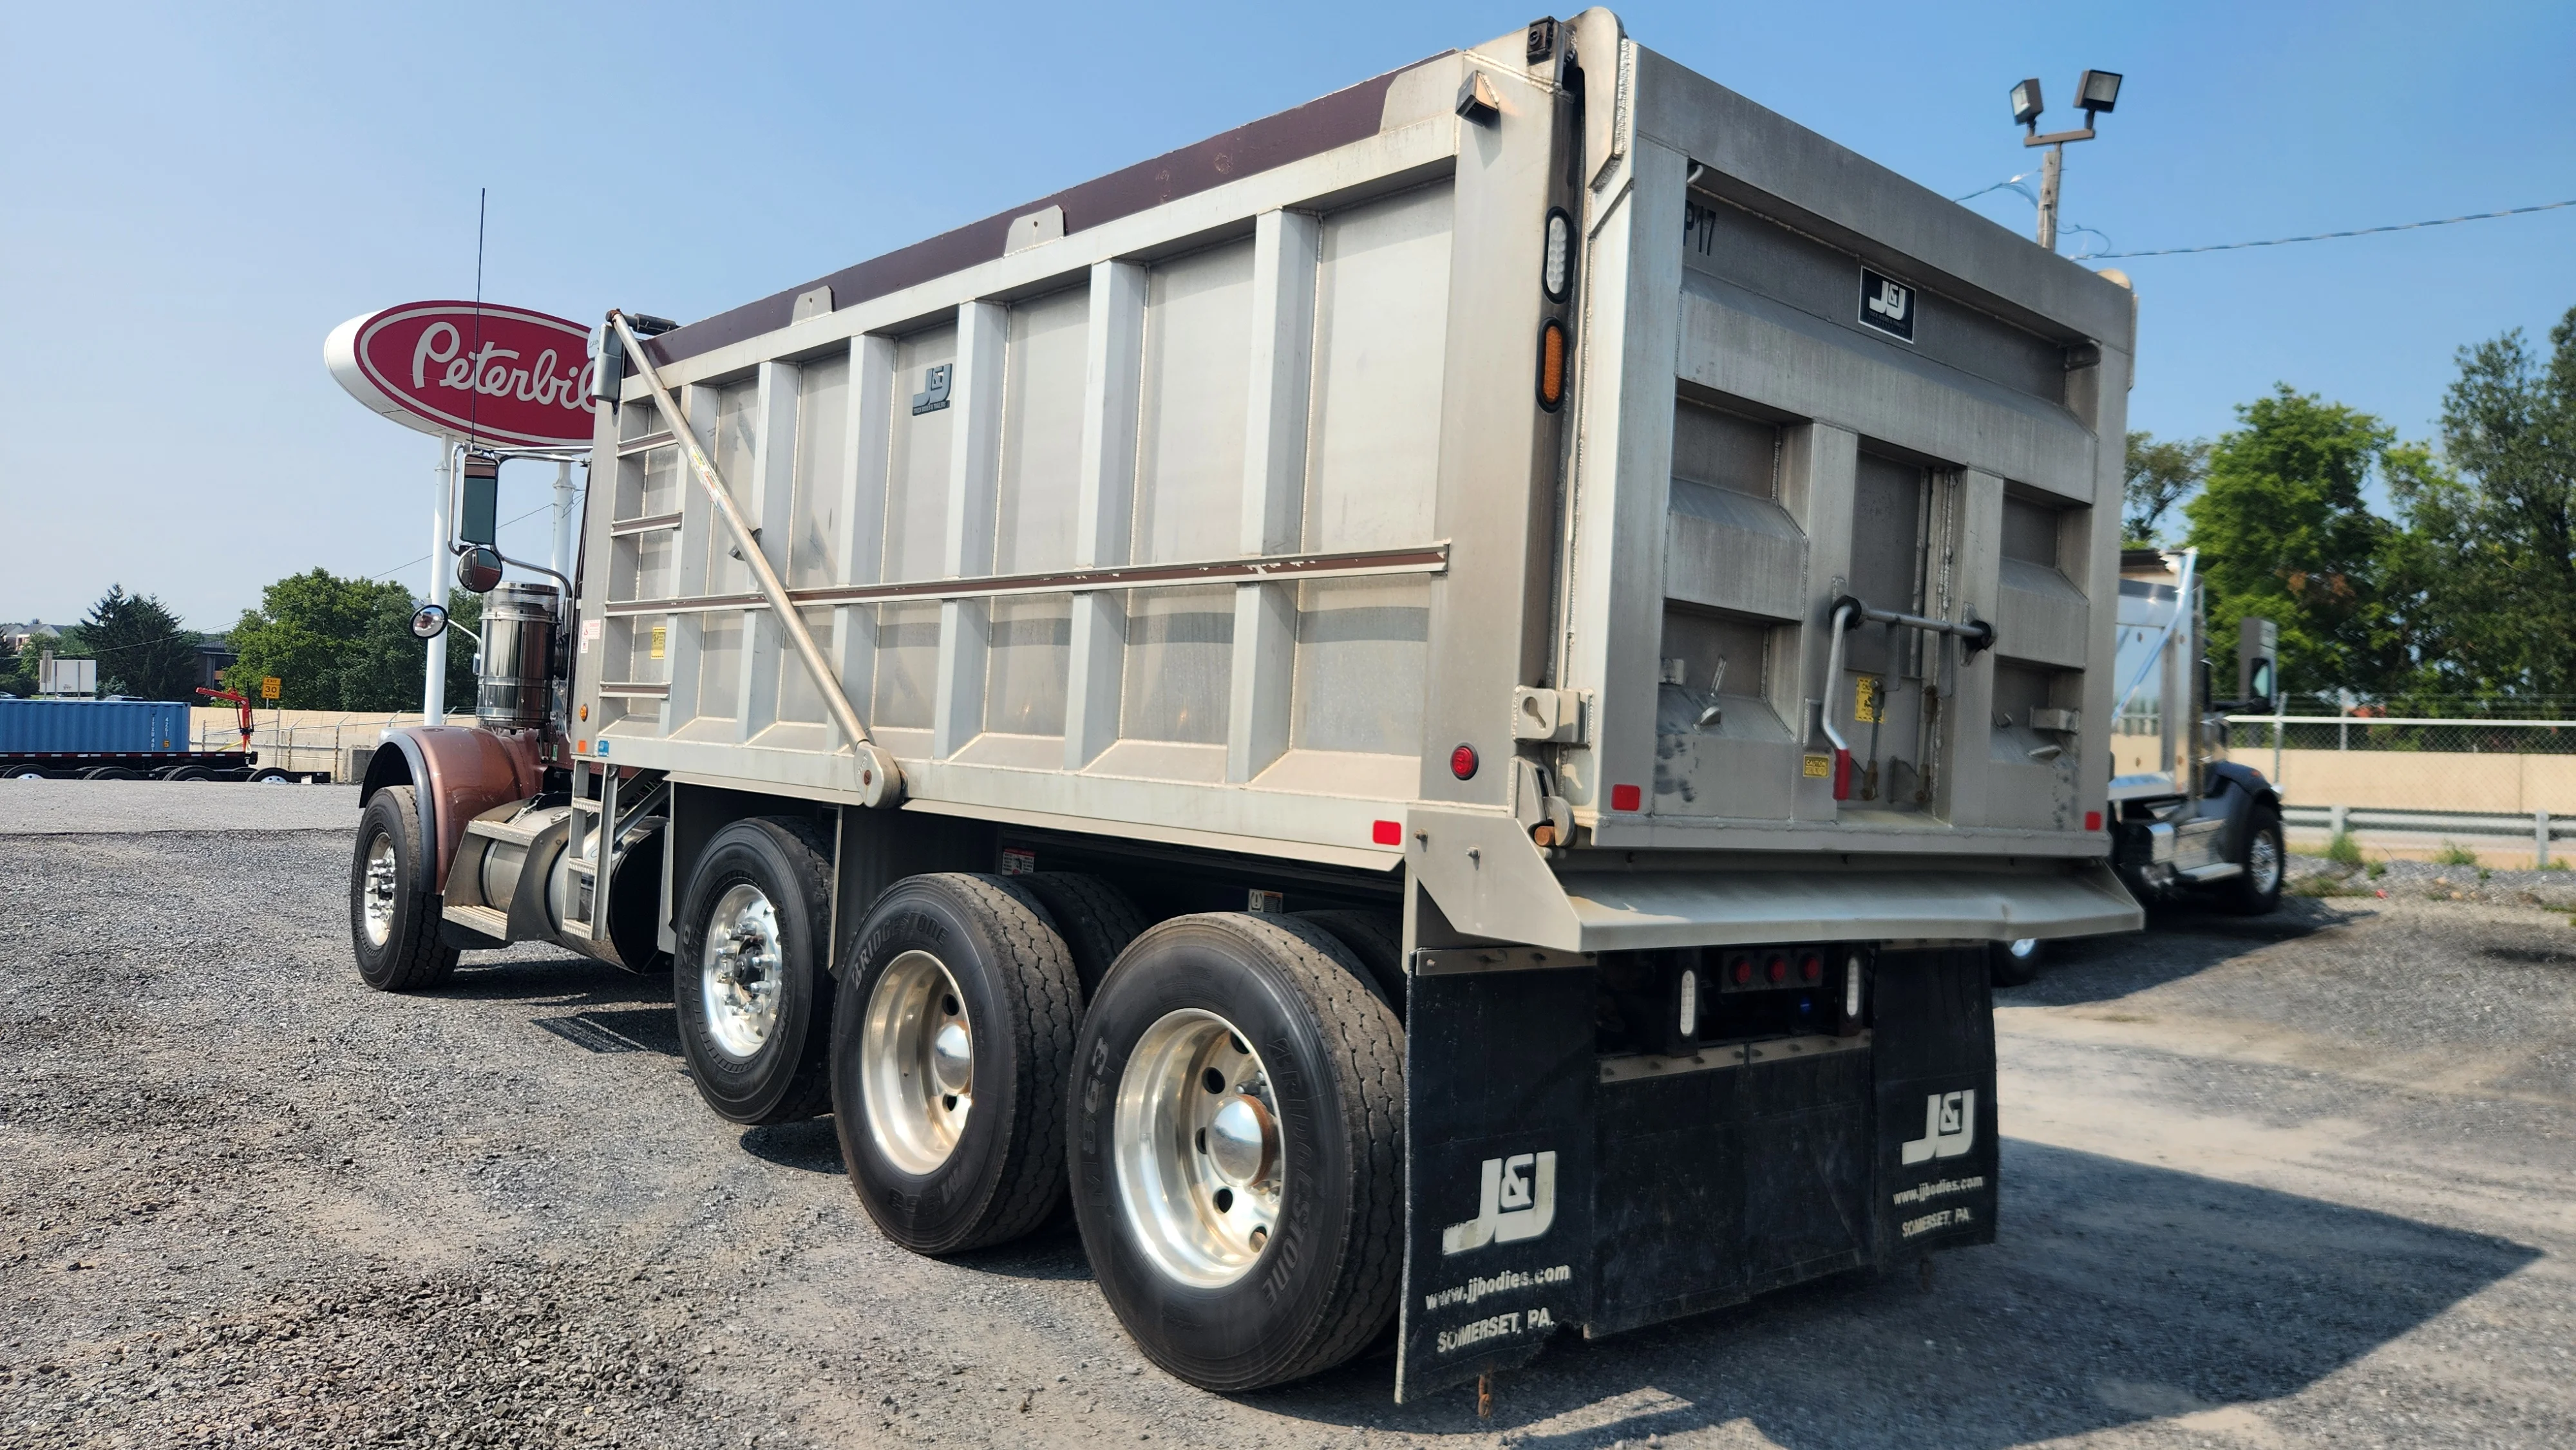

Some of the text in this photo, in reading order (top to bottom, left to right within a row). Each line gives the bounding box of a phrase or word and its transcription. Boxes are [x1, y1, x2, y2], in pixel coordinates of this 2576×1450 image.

[412, 321, 595, 413] Peterbil
[851, 910, 949, 991] BRIDGESTONE
[1902, 1089, 1975, 1165] J&J
[1442, 1151, 1557, 1256] J&J
[1893, 1176, 1984, 1205] www.jjbodies.com
[1426, 1265, 1572, 1310] www.jjbodies.com
